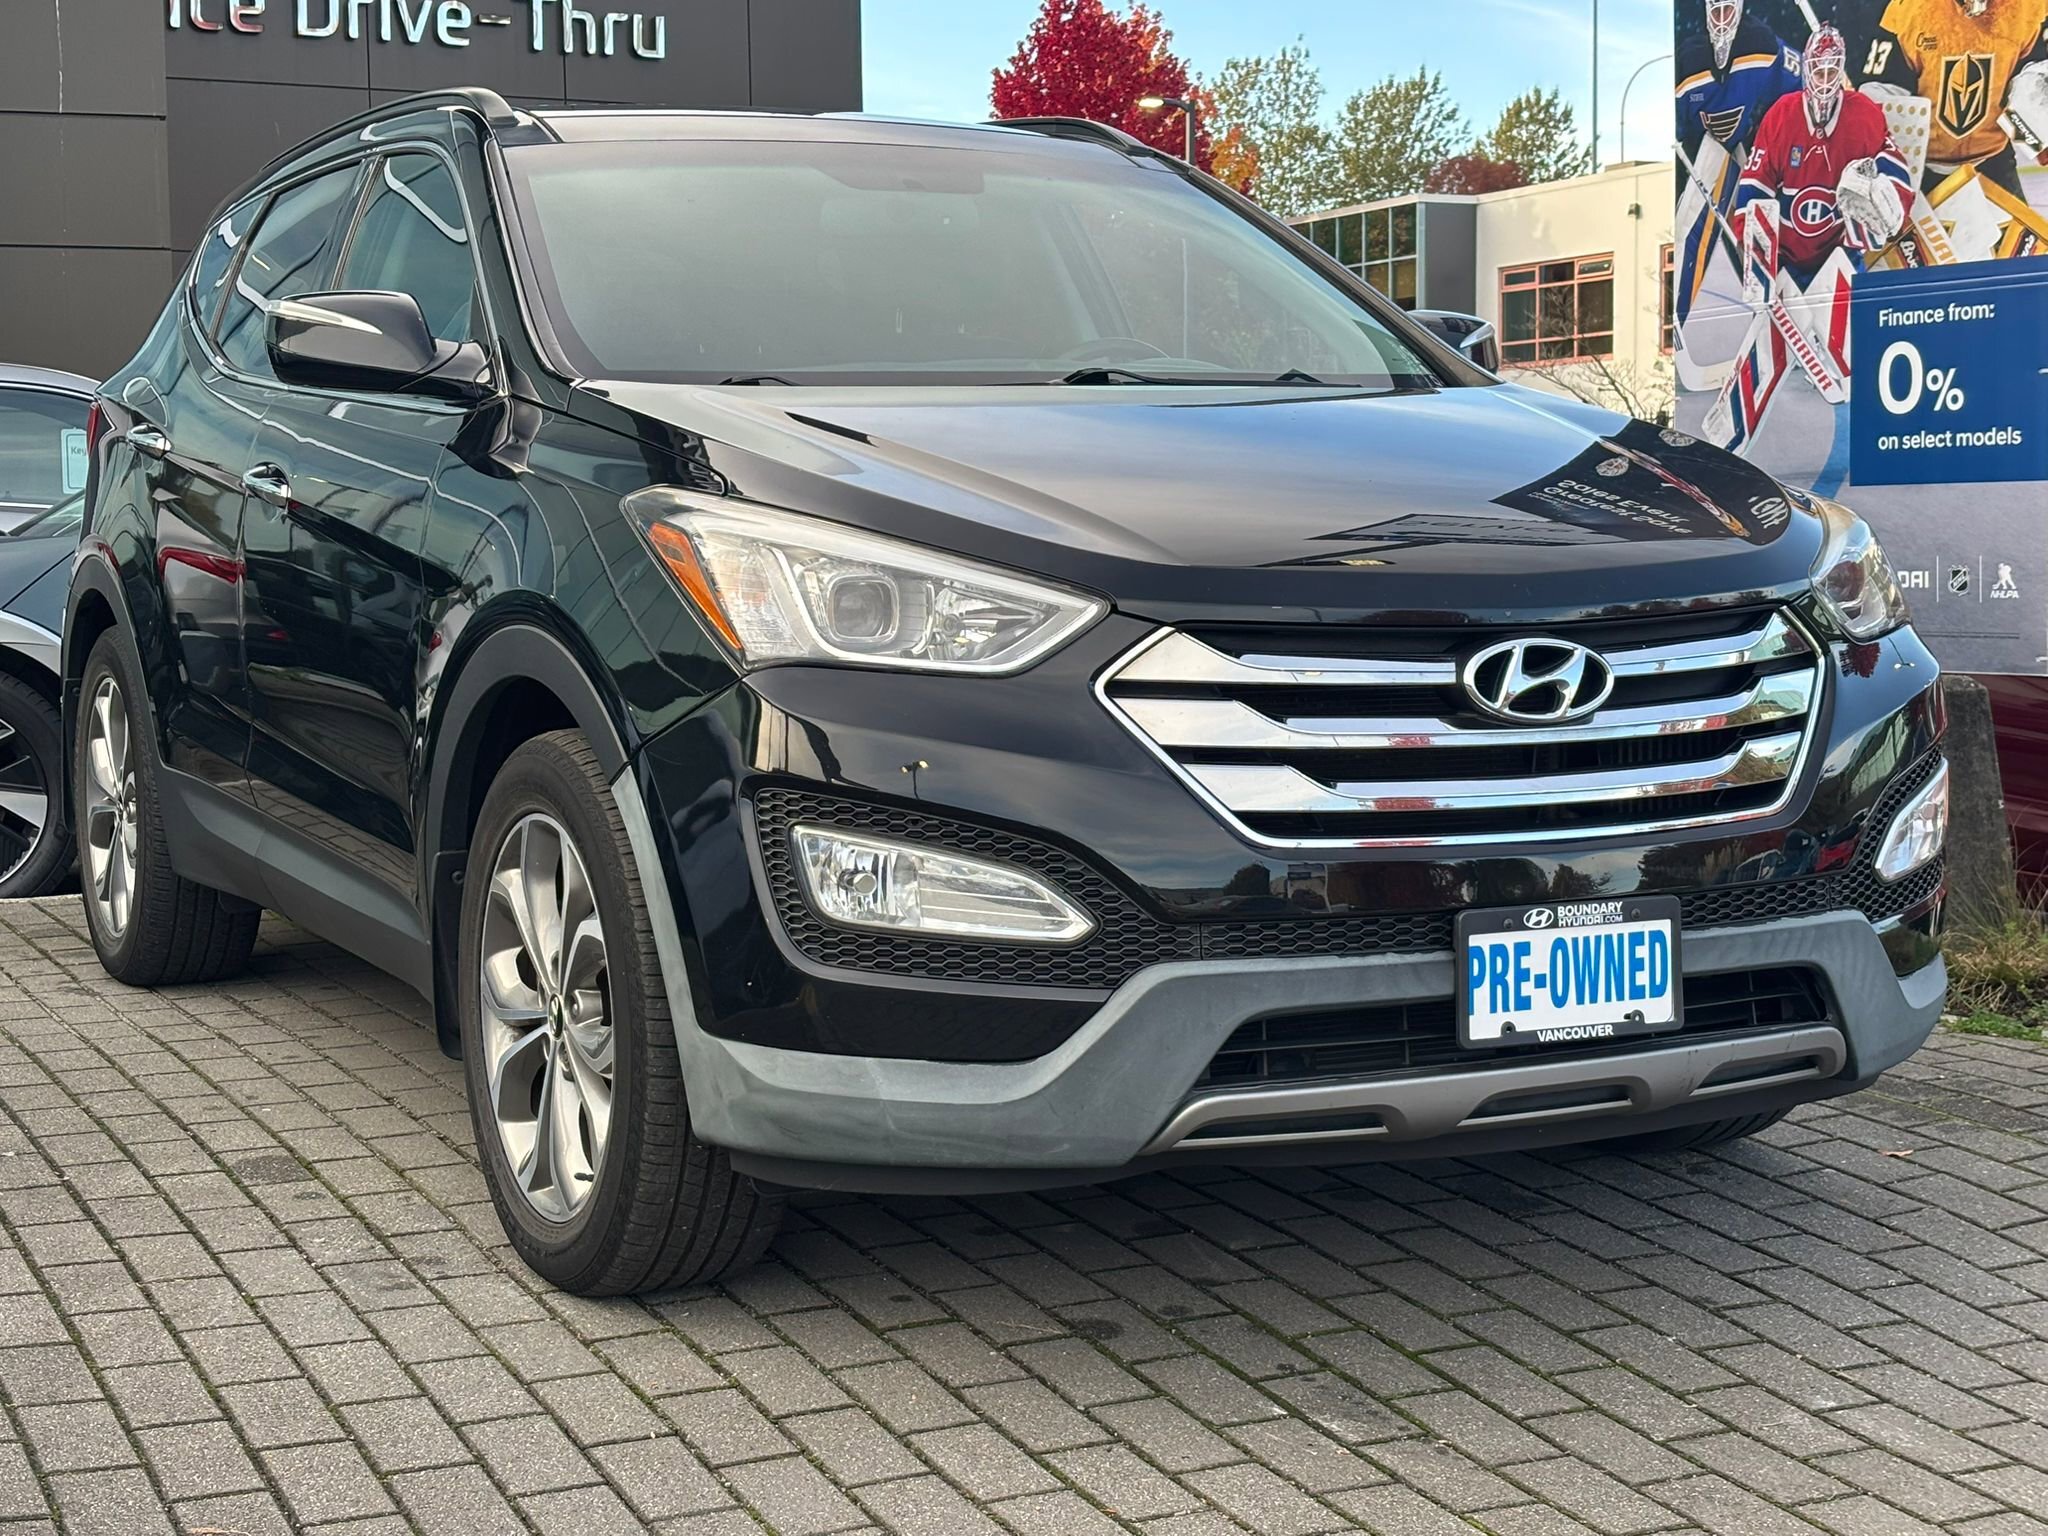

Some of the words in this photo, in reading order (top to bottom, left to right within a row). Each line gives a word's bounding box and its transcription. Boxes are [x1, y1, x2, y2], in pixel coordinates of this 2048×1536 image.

[298, 0, 665, 60] Drive-Thru
[1743, 145, 1765, 172] 35
[1878, 307, 1945, 328] Finance
[1948, 303, 1996, 322] from:
[1878, 340, 1965, 415] 0%
[1878, 435, 1899, 451] on
[1902, 430, 1953, 449] select
[1955, 426, 2023, 447] models
[1989, 589, 2020, 599] NHLPA
[1557, 901, 1623, 918] BOUNDARY
[1558, 914, 1624, 928] HYUNDAI.COM
[1468, 929, 1669, 1016] PRE-OWNED
[1536, 1023, 1614, 1043] VANCOUVER
